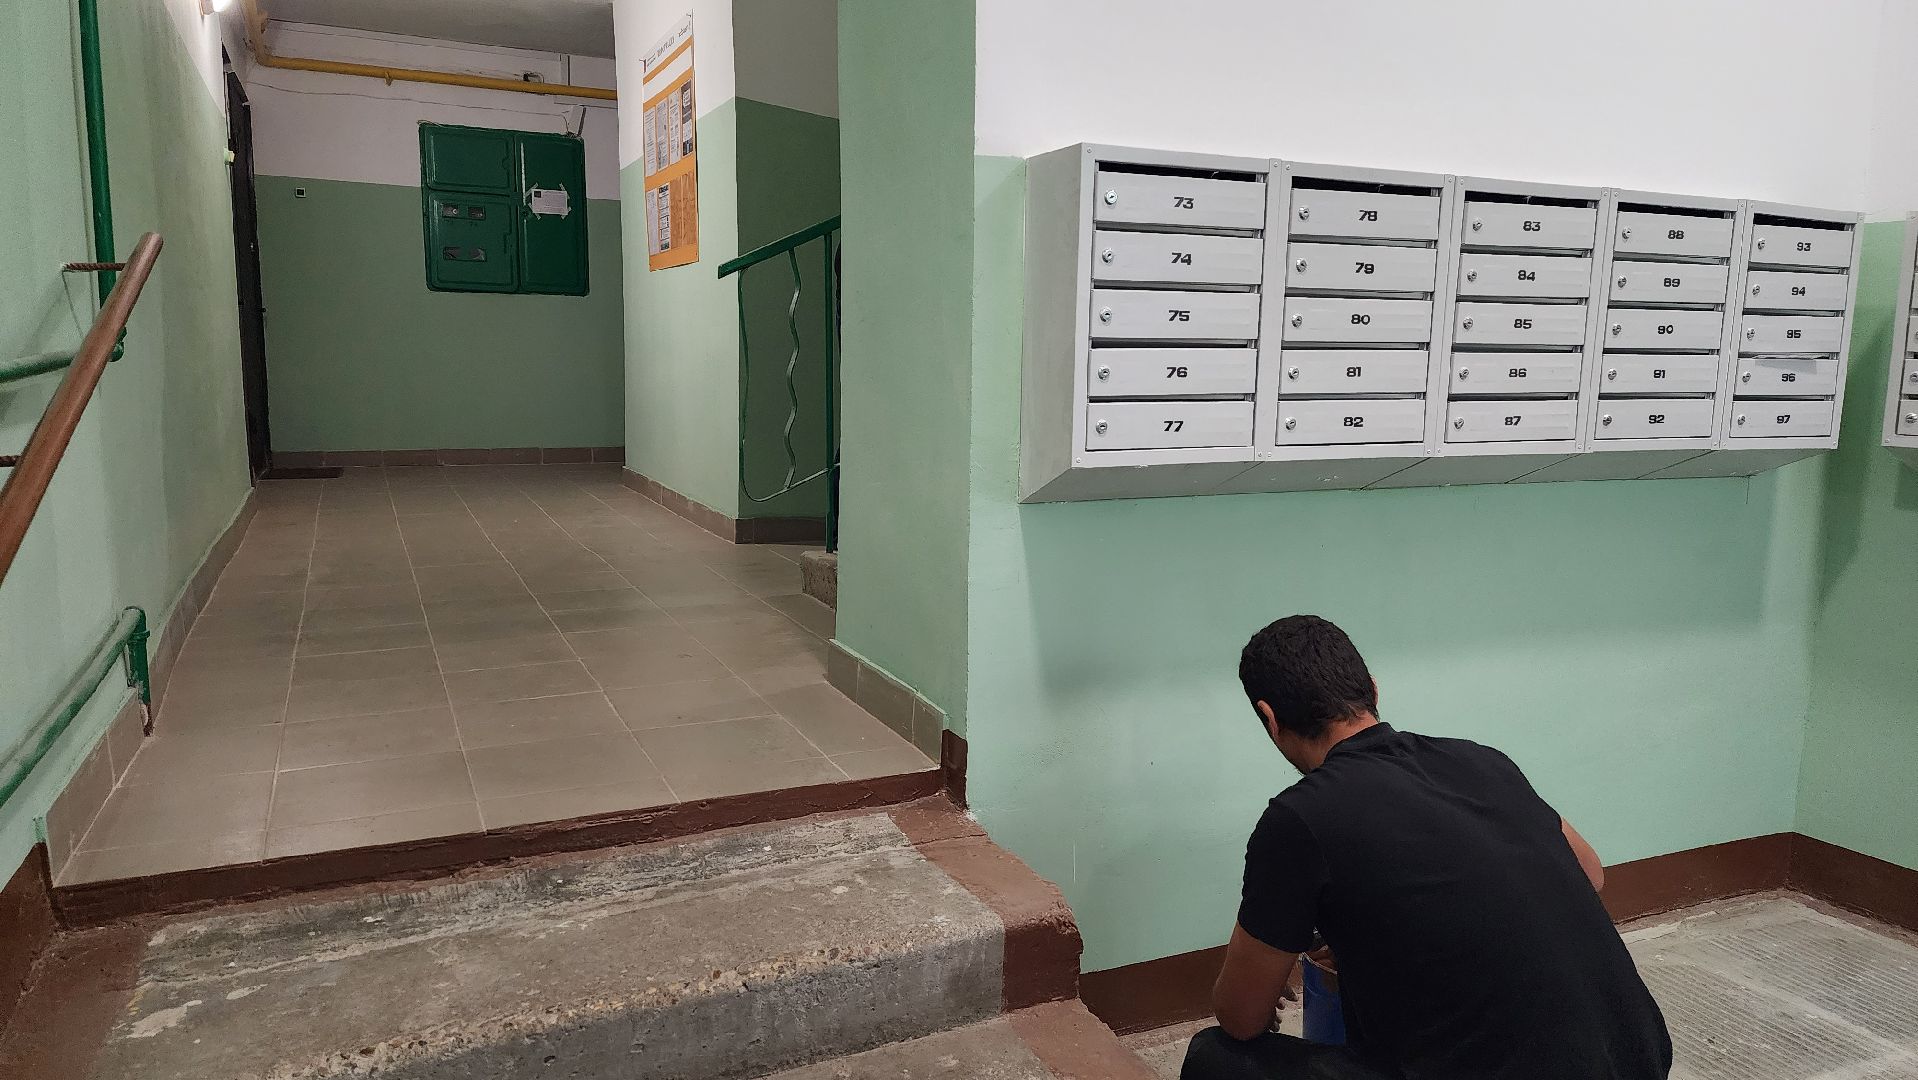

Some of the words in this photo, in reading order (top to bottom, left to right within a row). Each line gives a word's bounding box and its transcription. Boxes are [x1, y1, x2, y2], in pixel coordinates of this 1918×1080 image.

[1173, 196, 1195, 210] 73
[1358, 209, 1378, 222] 78
[1522, 220, 1541, 232] 83
[1667, 229, 1685, 240] 88
[1796, 241, 1812, 252] 93
[1171, 252, 1192, 266] 74
[1355, 261, 1375, 275] 79
[1517, 269, 1536, 282] 84
[1663, 277, 1681, 288] 89
[1791, 286, 1806, 297] 94
[1168, 309, 1191, 322] 75
[1350, 313, 1371, 326] 80
[1513, 318, 1533, 330] 85
[1657, 324, 1674, 335] 90
[1786, 329, 1802, 339] 95
[1166, 366, 1188, 379] 76
[1346, 366, 1362, 378] 81
[1508, 368, 1528, 378] 86
[1781, 372, 1796, 383] 96
[1343, 416, 1364, 428] 82
[1504, 415, 1522, 426] 87
[1648, 414, 1665, 425] 92
[1776, 414, 1791, 425] 97
[1163, 420, 1184, 433] 77
